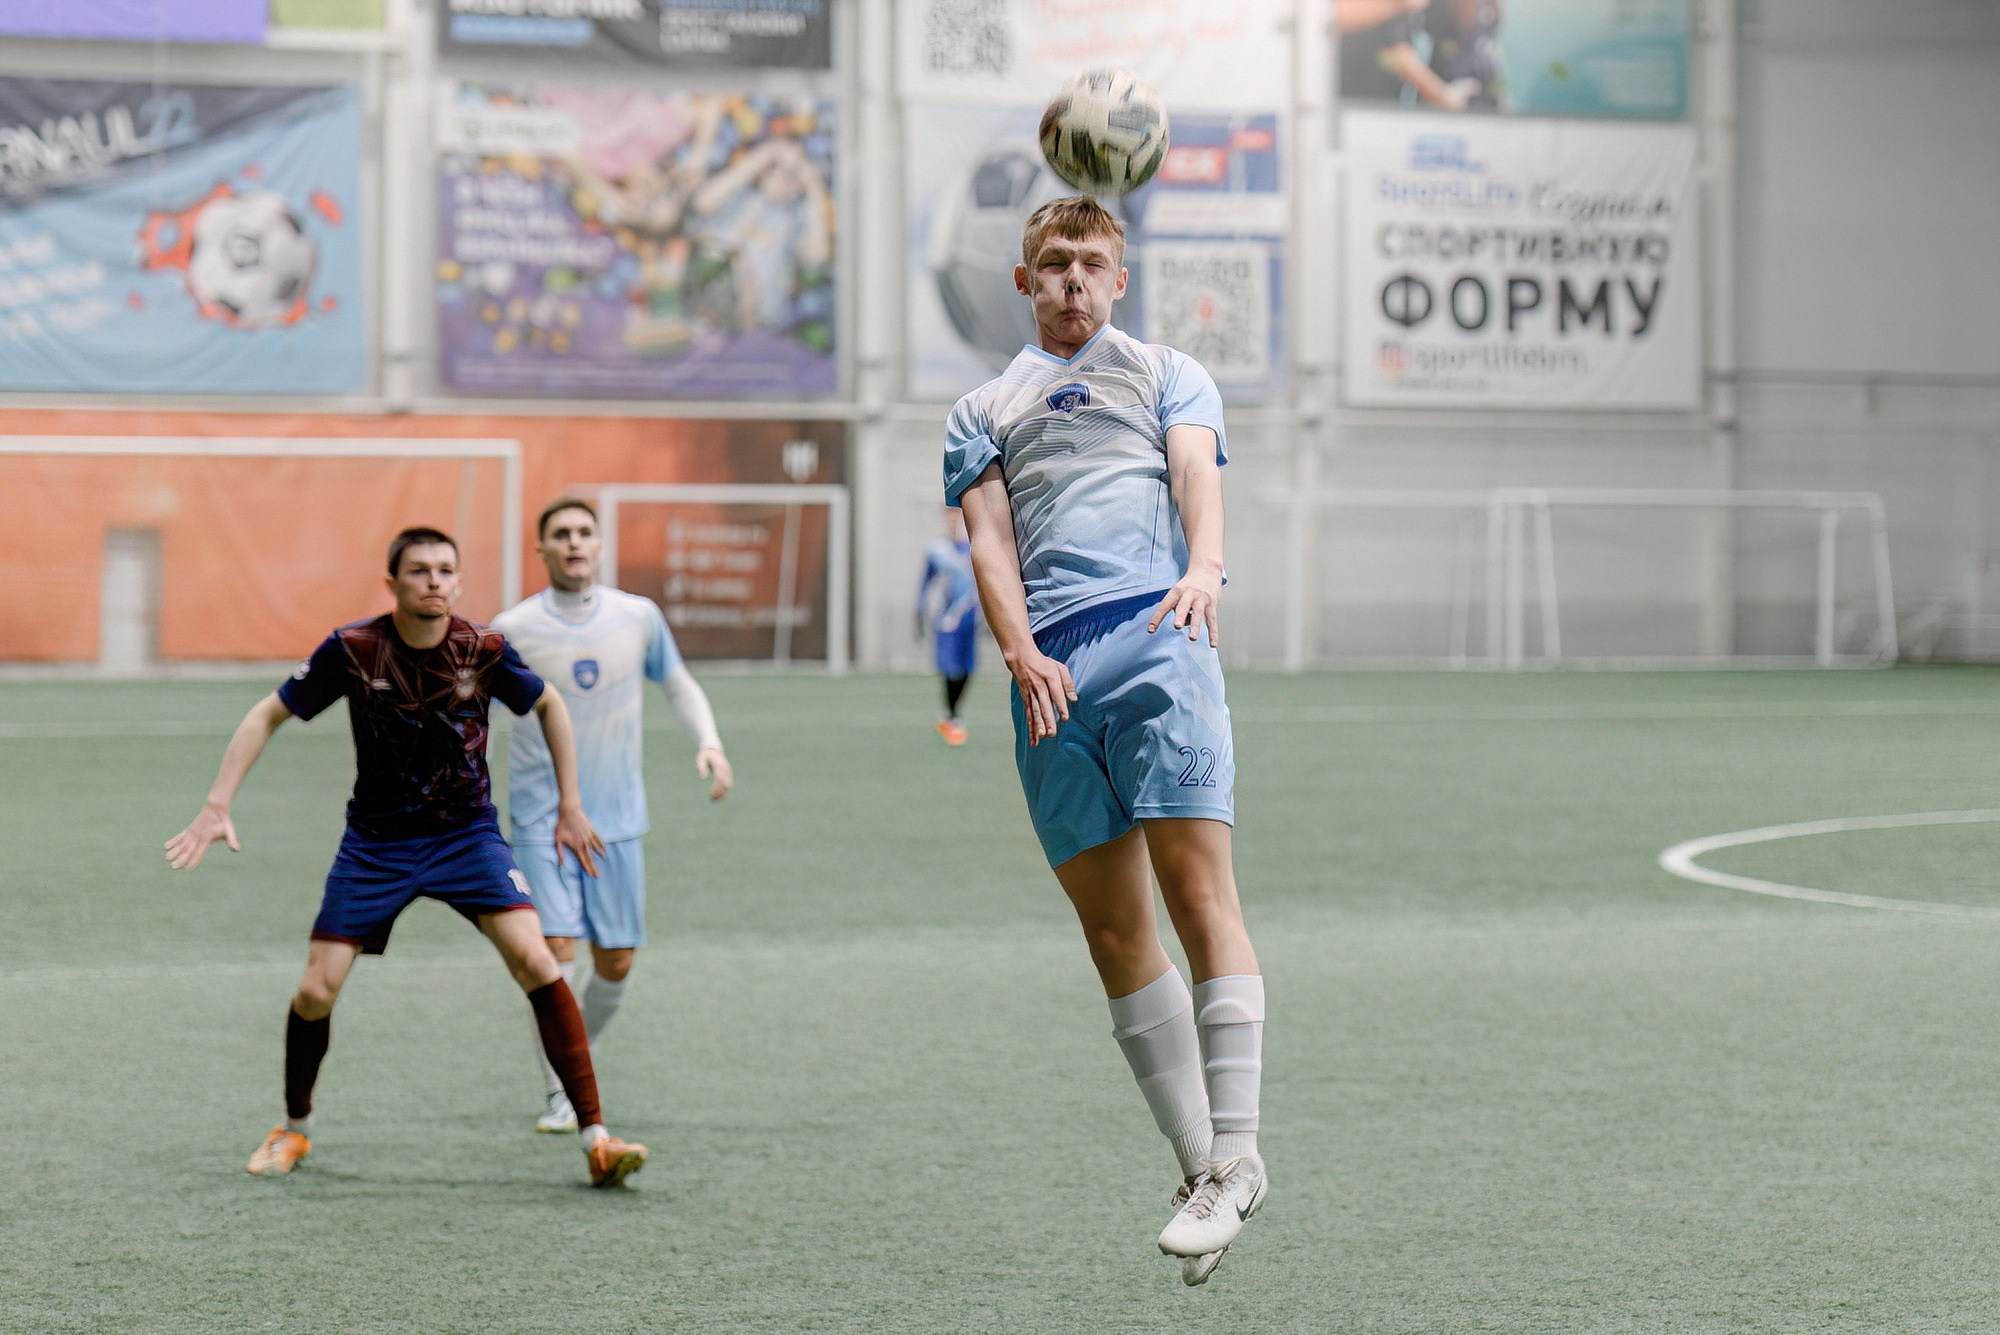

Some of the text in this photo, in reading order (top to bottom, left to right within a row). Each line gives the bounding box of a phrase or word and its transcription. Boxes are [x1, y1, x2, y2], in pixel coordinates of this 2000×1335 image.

[1377, 224, 1671, 265] СПОРТИВНУЮ
[1378, 273, 1663, 338] ФОРМУ
[1178, 745, 1217, 787] 22
